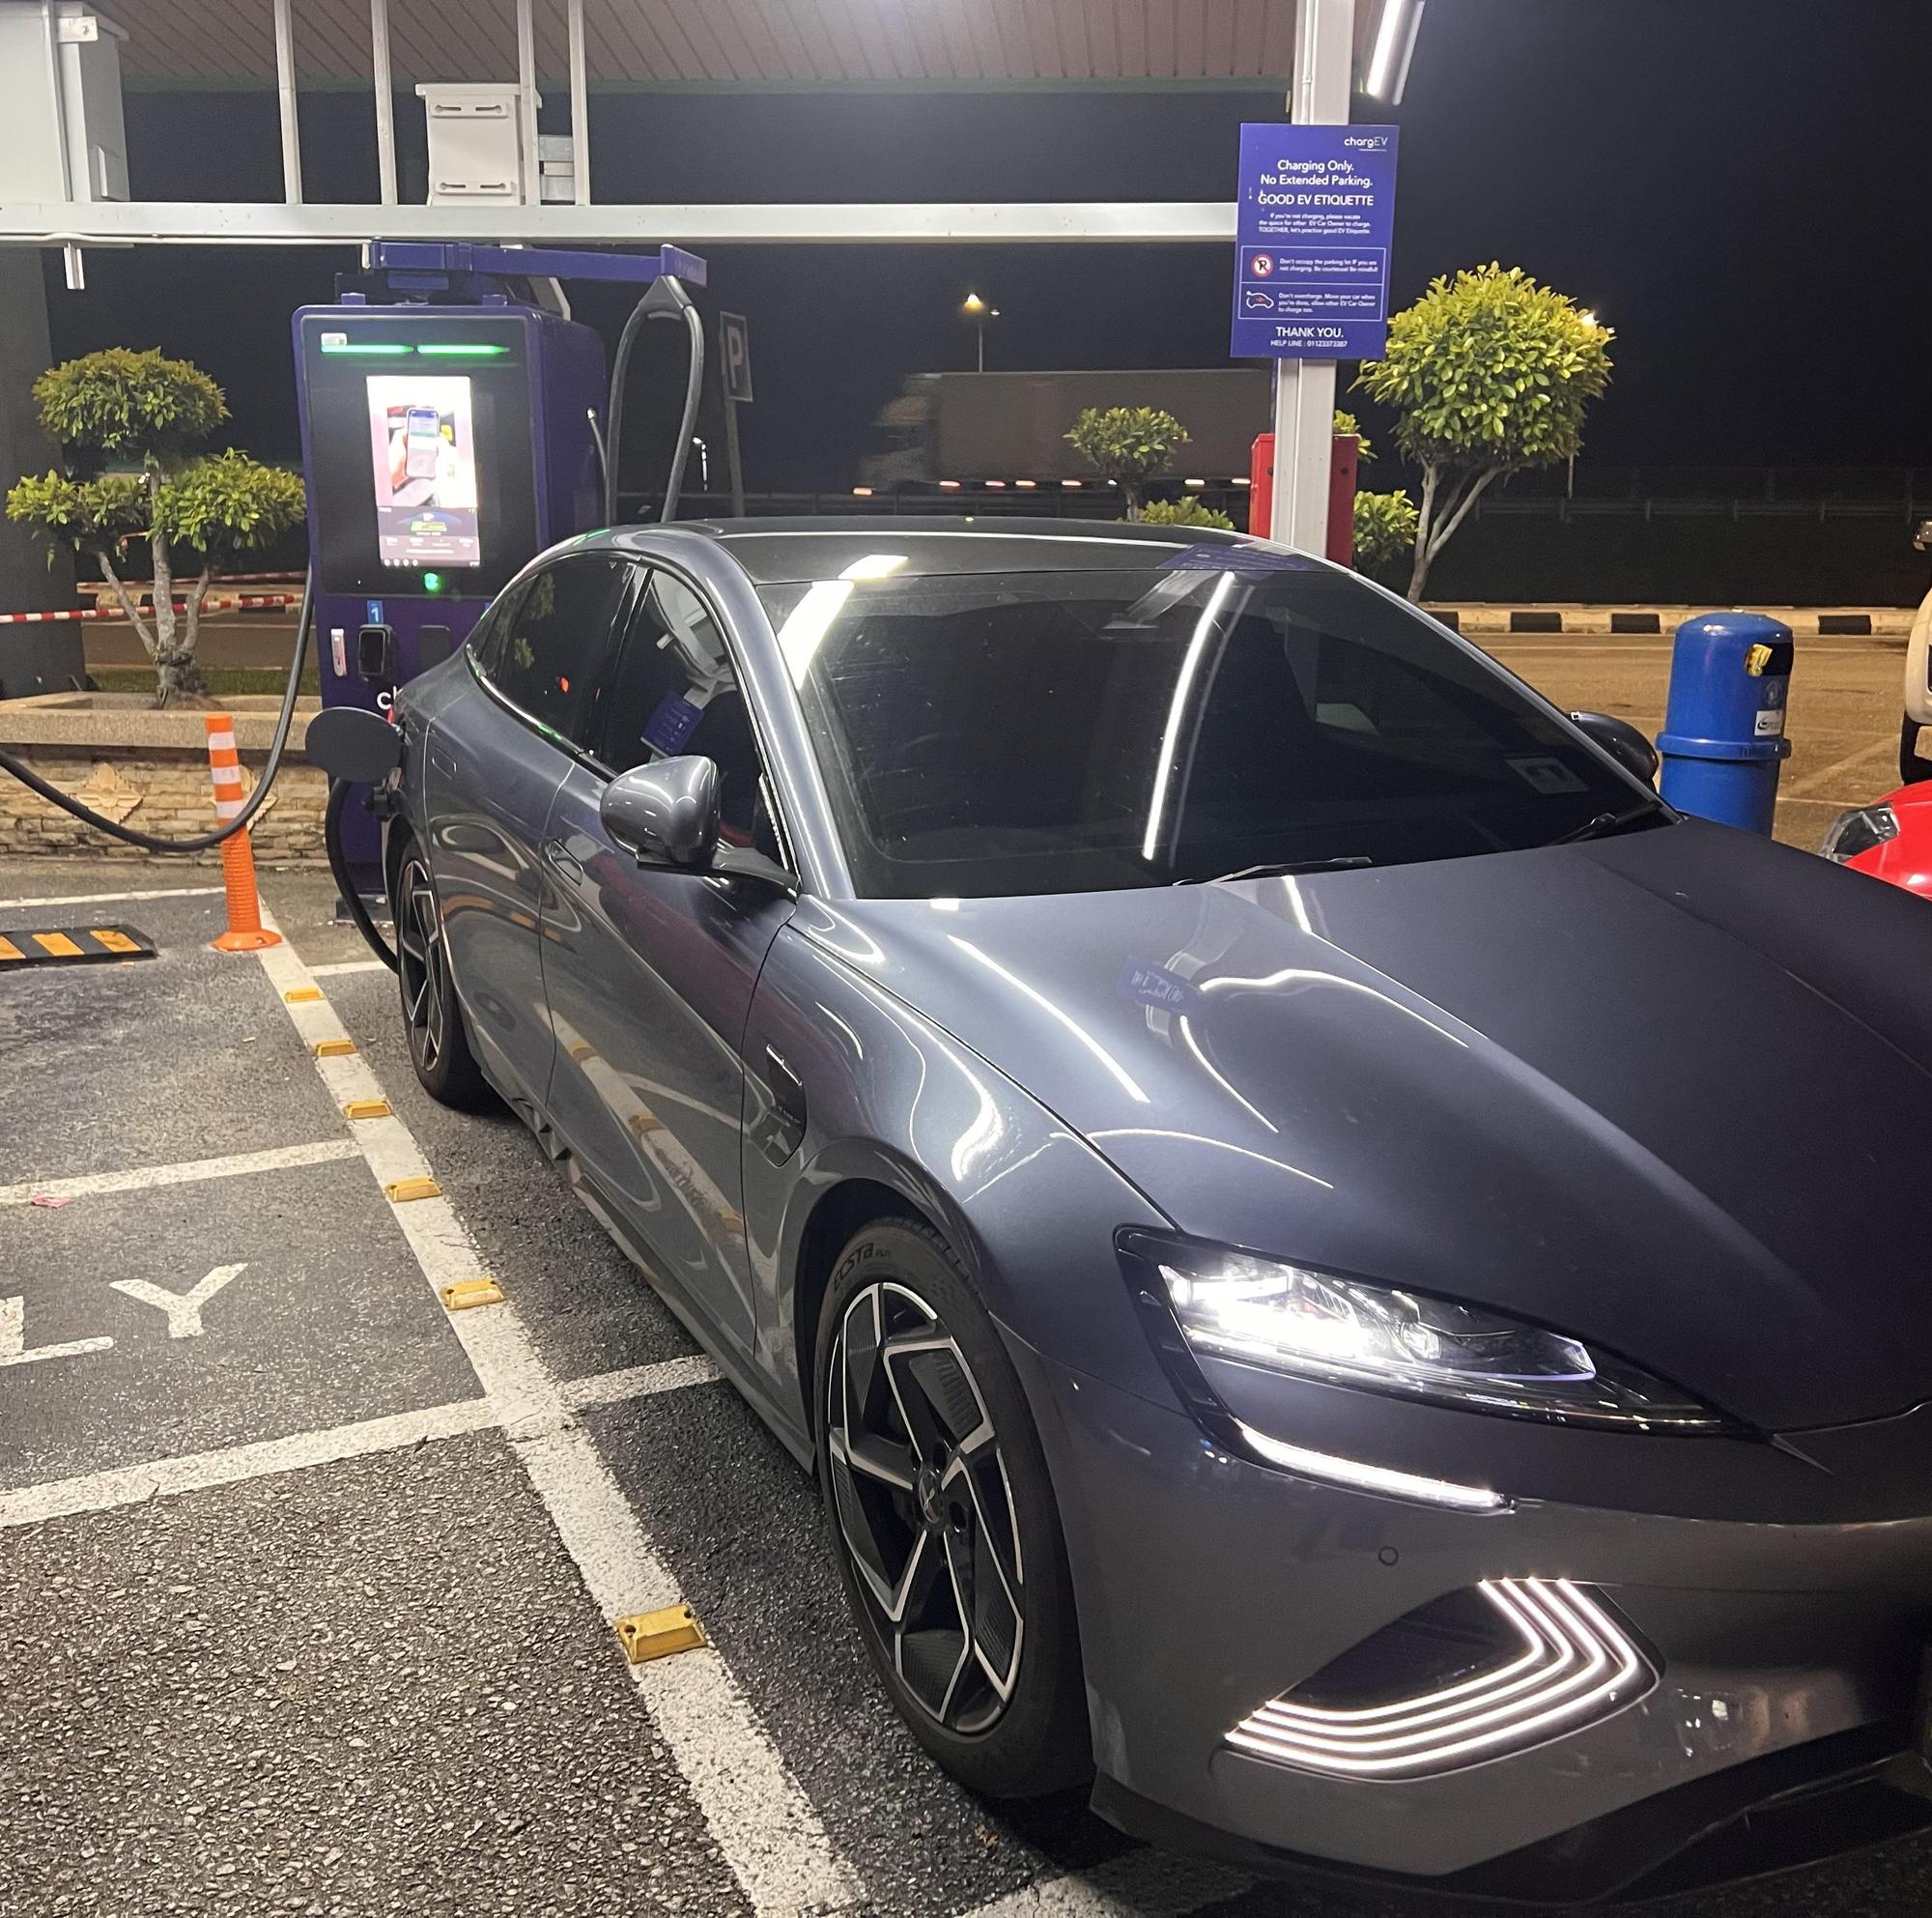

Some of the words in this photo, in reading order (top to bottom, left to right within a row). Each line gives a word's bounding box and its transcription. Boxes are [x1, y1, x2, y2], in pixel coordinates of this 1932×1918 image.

[1277, 159, 1324, 173] Charging
[1327, 159, 1354, 172] Only.
[1261, 174, 1276, 186] No
[1279, 174, 1329, 186] Extended
[1331, 175, 1373, 188] Parking.
[1258, 194, 1294, 205] GOOD
[1297, 194, 1312, 205] EV
[1314, 195, 1374, 206] ETIQUETTE
[1275, 327, 1314, 337] THANK
[1317, 327, 1344, 338] YOU.
[727, 326, 743, 388] P
[371, 607, 379, 623] 1
